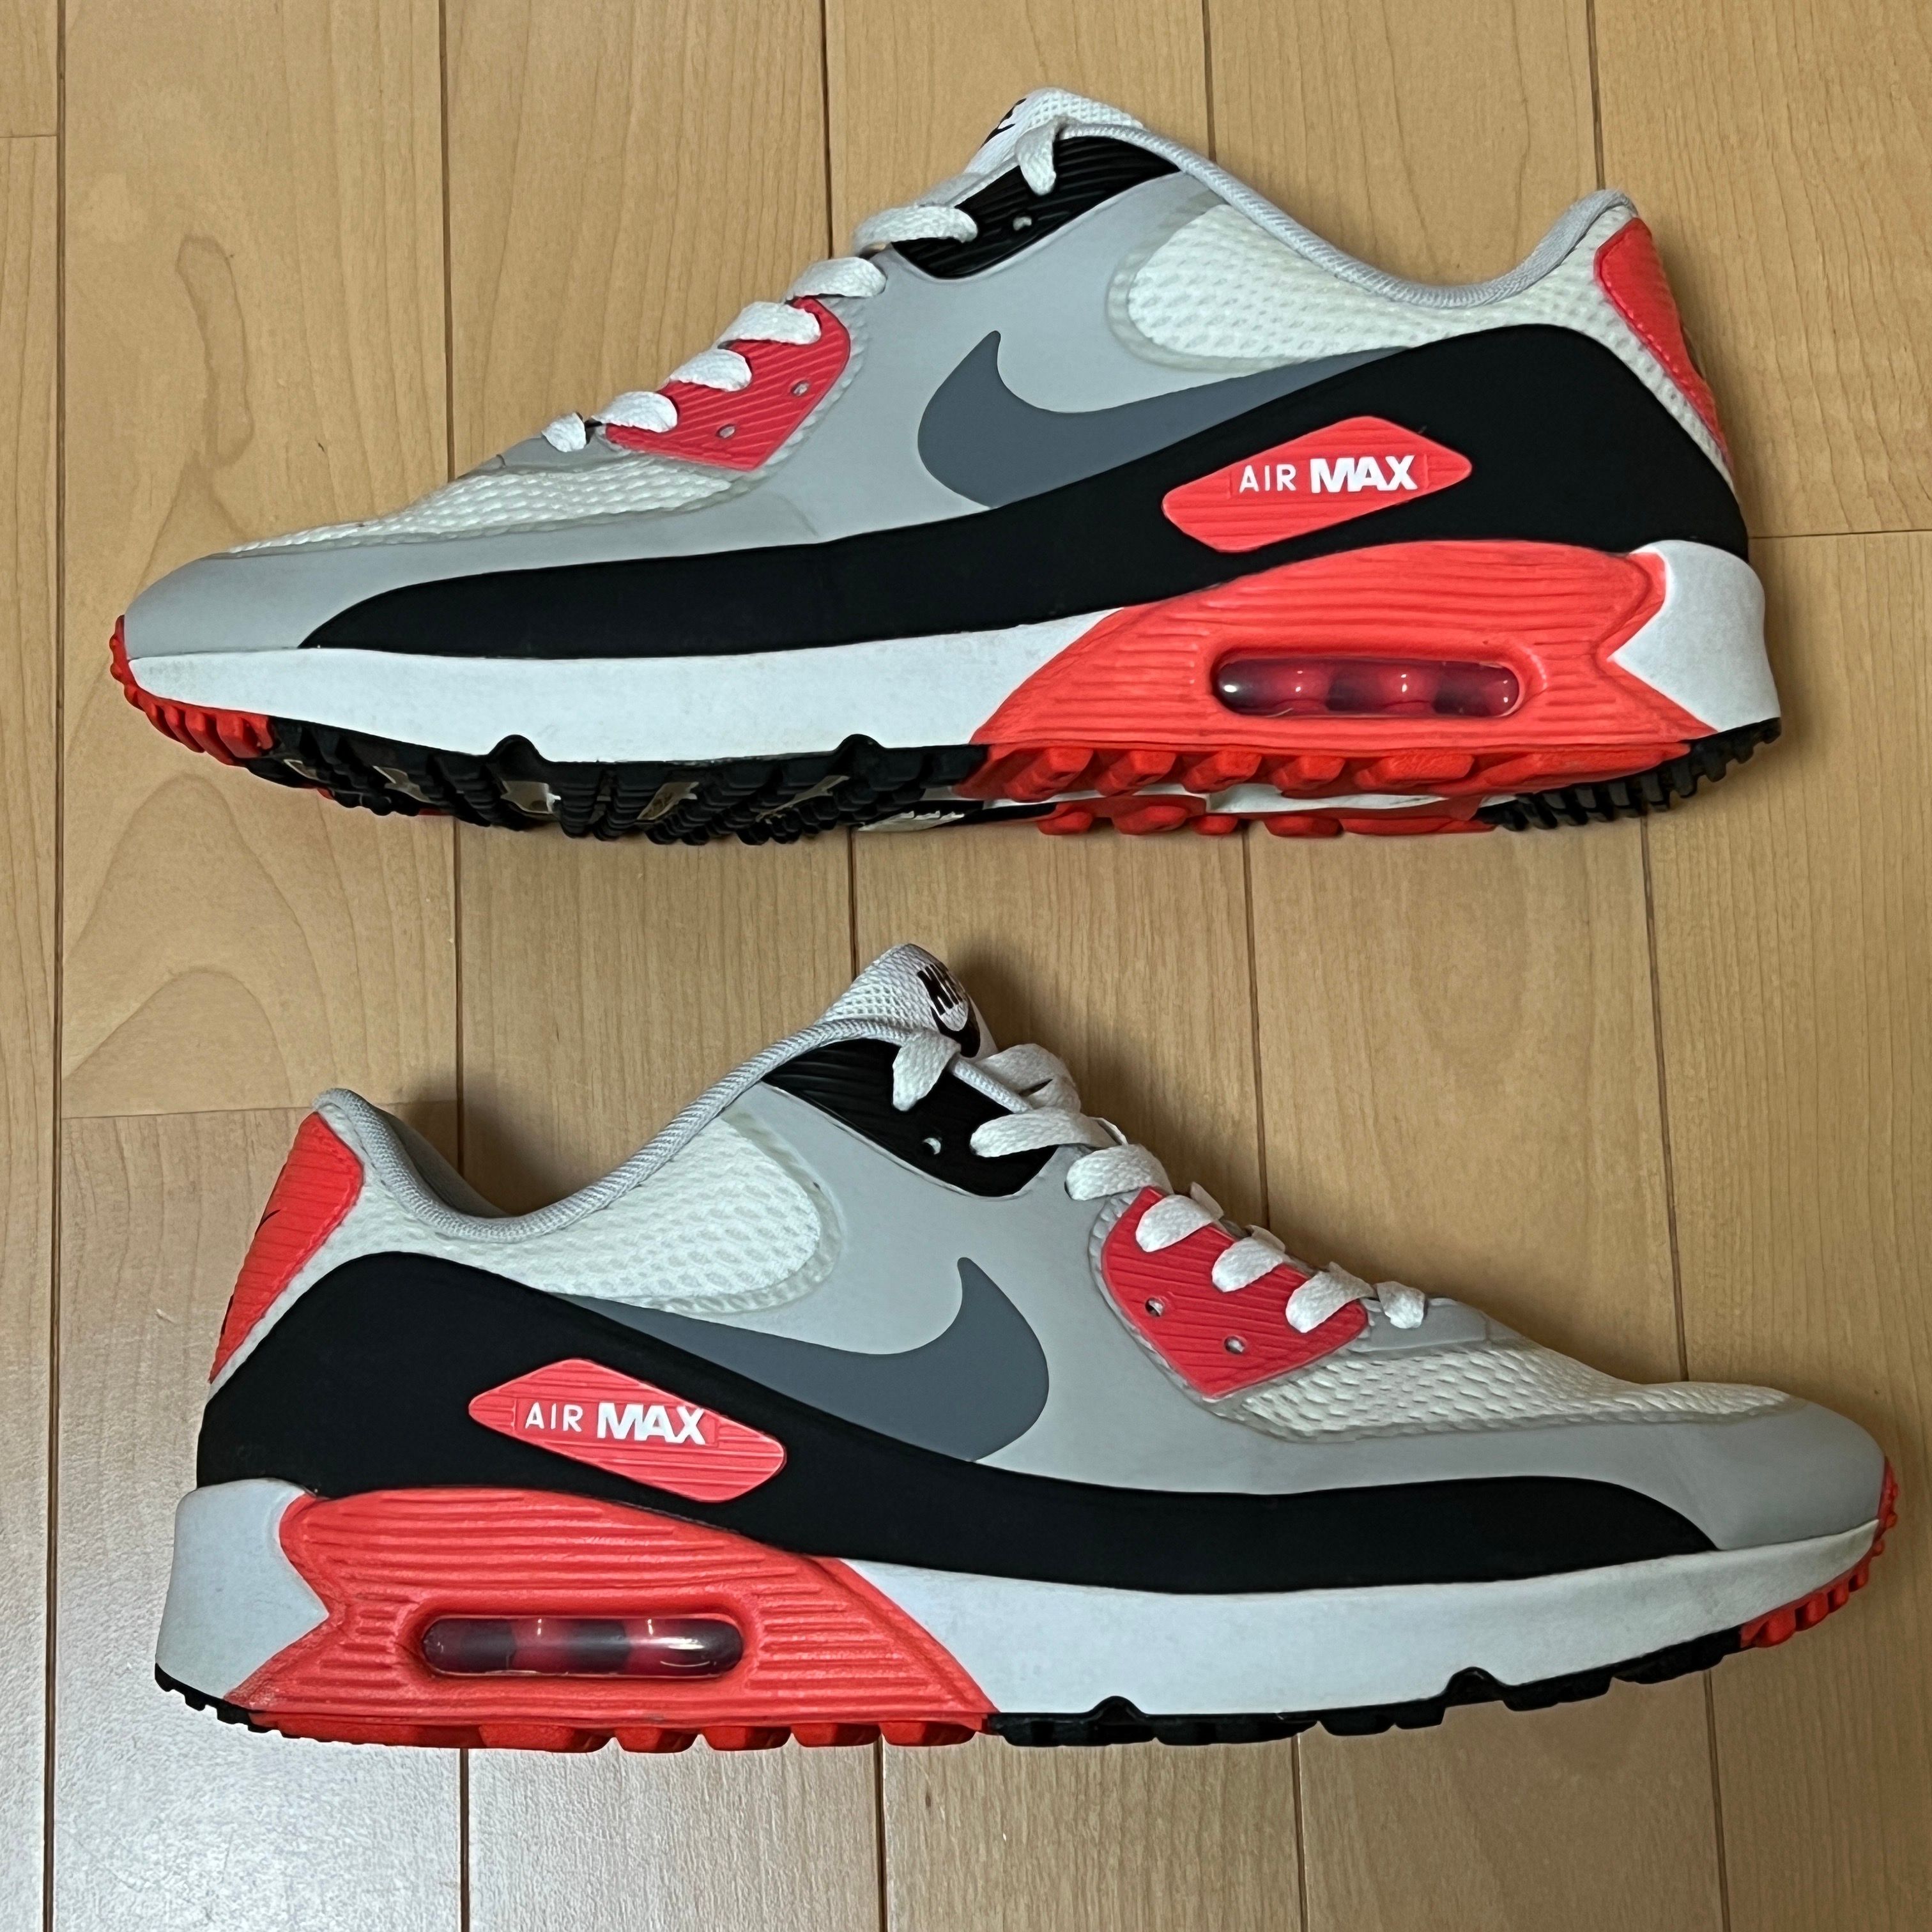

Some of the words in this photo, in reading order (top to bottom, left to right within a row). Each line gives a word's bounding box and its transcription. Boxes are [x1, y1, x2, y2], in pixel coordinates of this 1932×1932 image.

[1239, 464, 1296, 493] AIR
[1310, 455, 1418, 493] MAX
[525, 1402, 583, 1432] AIR
[597, 1402, 706, 1445] MAX
